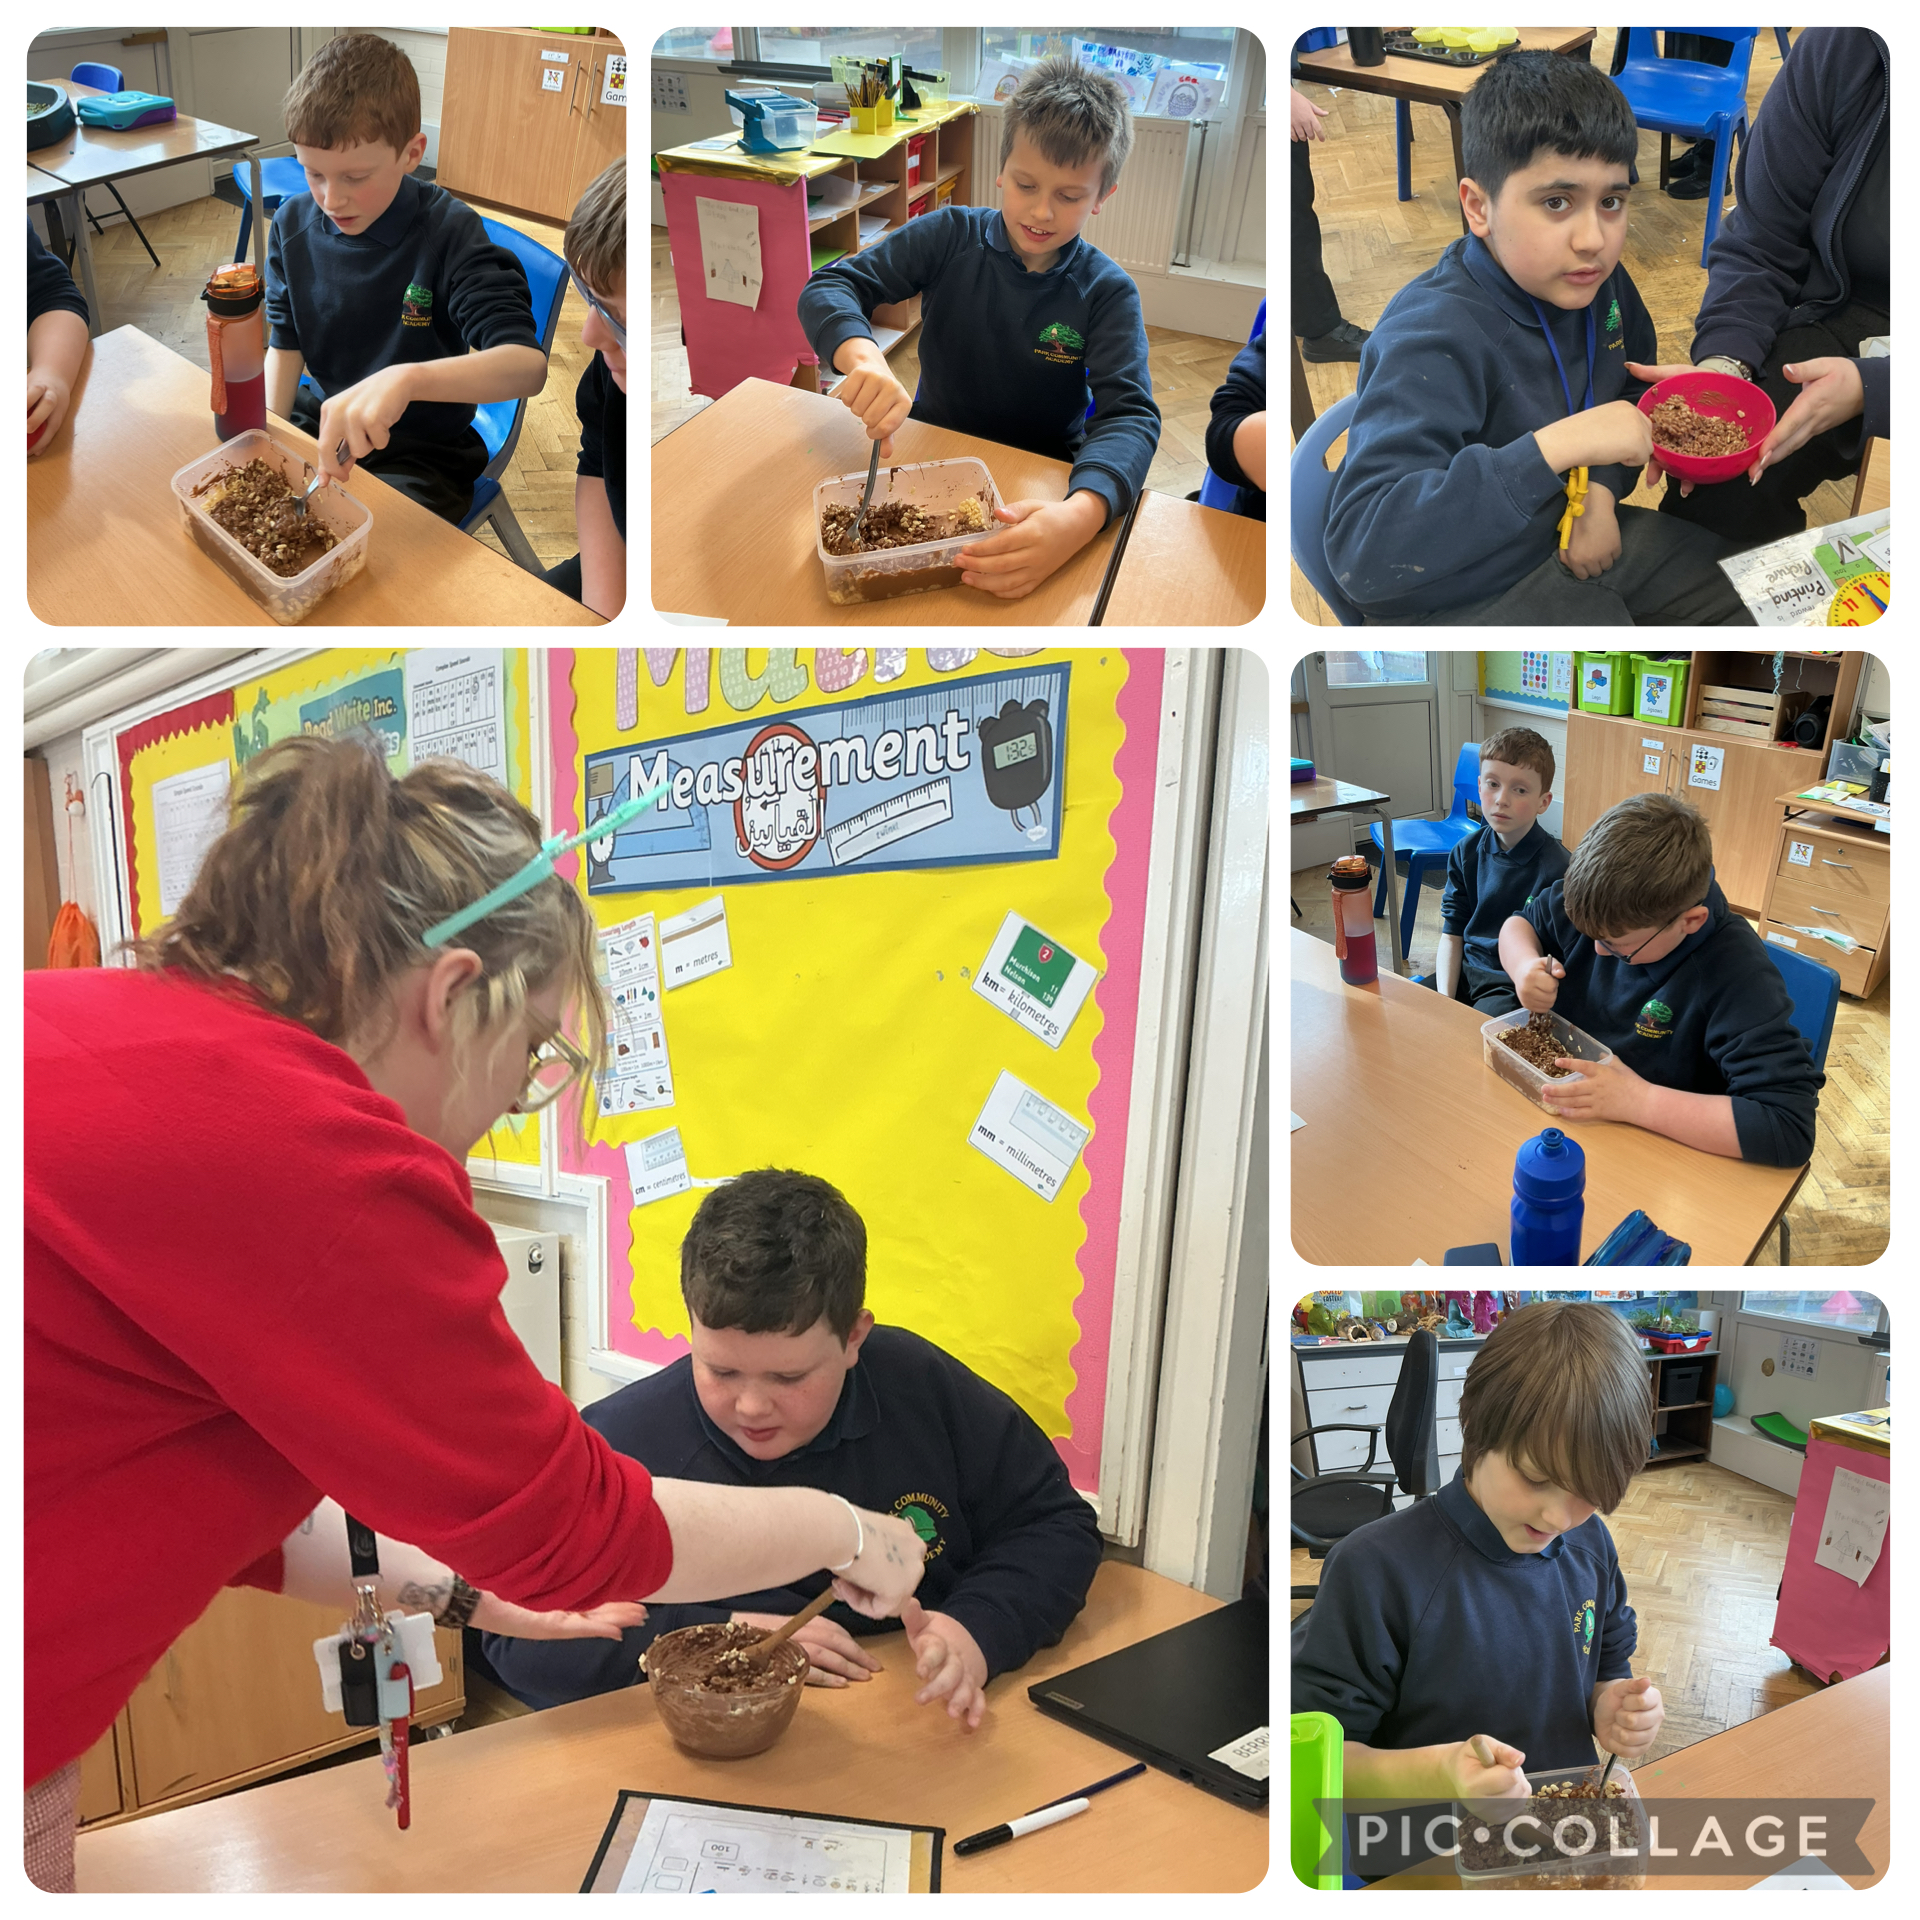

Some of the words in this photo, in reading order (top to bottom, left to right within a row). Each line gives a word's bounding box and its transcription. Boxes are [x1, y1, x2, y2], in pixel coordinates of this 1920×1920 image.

[606, 91, 627, 103] Gam
[1034, 349, 1049, 357] PARK
[1765, 560, 1812, 584] Picture
[1766, 580, 1826, 608] Printing
[1842, 598, 1859, 612] 11
[1790, 604, 1815, 618] reward
[1592, 694, 1602, 702] Lego
[335, 699, 370, 732] Write
[373, 698, 397, 718] Inc.
[1646, 706, 1663, 715] Jigsaws
[1006, 739, 1028, 761] 1:32
[629, 711, 971, 812] Measurement
[1692, 775, 1717, 787] Games
[675, 965, 683, 974] m
[693, 951, 719, 967] metres
[1042, 949, 1050, 959] 2
[1004, 965, 1026, 985] Nelson
[1009, 956, 1041, 983] Murchison
[1042, 991, 1054, 1005] 139
[1050, 984, 1058, 995] 11
[1007, 989, 1060, 1036] kilometres
[978, 1125, 996, 1142] mm
[1006, 1145, 1058, 1188] millimetres
[635, 1186, 645, 1195] cm
[653, 1172, 686, 1189] centimetres
[894, 1492, 949, 1518] COMMUNITY
[924, 1537, 946, 1562] DEMY
[1573, 1609, 1585, 1633] PARK
[711, 1844, 730, 1853] 100
